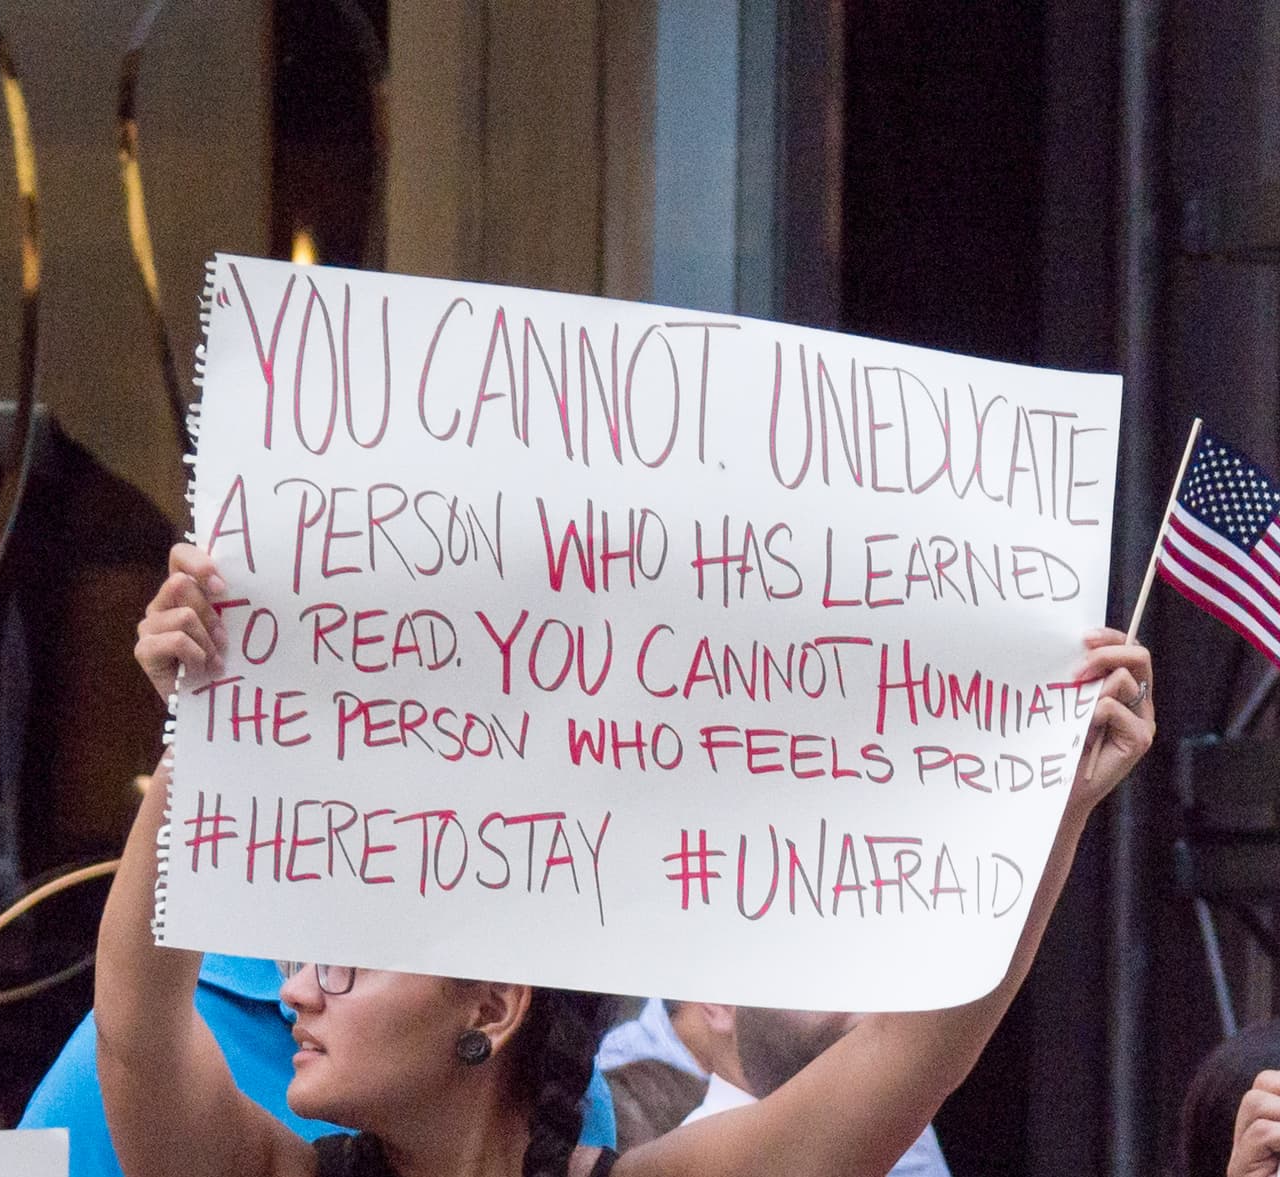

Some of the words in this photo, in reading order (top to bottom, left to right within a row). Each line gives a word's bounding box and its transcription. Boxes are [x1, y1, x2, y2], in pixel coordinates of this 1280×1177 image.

[769, 341, 1108, 526] UNEDUCATE
[207, 474, 256, 574] A
[273, 478, 504, 594] PERSON
[536, 497, 668, 594] WHO
[690, 515, 803, 609] HAS
[822, 527, 1081, 609] LEARNED
[299, 602, 462, 673] READ.
[475, 609, 613, 697] YOU
[637, 624, 873, 702] CANNOT
[192, 675, 312, 746] THE
[333, 691, 530, 762] PERSON
[568, 718, 683, 772] WHO
[699, 725, 895, 784] FEELS
[184, 791, 612, 926] #HERETOSTAY
[663, 818, 1024, 921] #UNAFRAID
